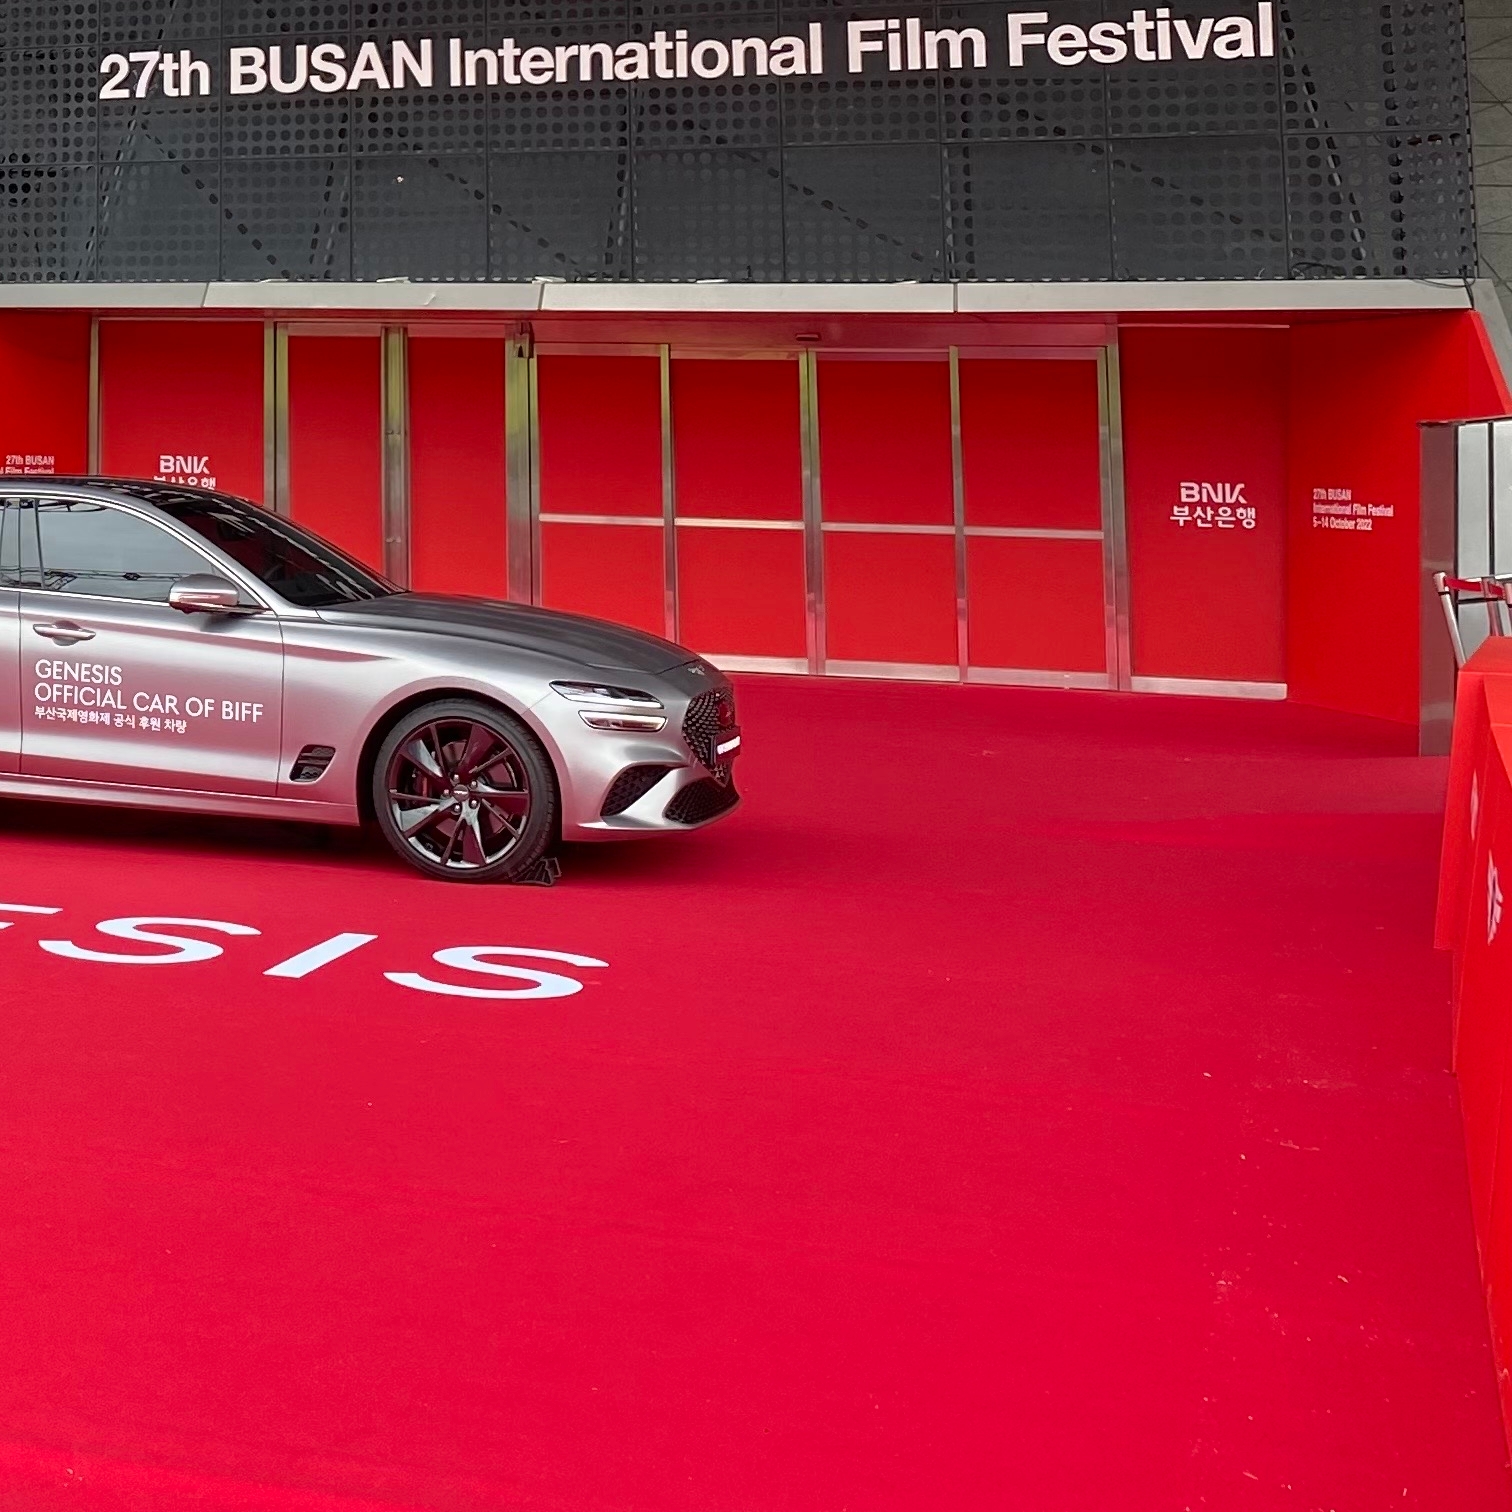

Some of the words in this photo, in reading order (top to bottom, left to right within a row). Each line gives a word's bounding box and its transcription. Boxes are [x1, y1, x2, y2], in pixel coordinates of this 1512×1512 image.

[99, 49, 210, 100] 27th
[230, 39, 432, 94] BUSAN
[450, 23, 821, 87] International
[848, 17, 986, 72] Film
[1009, 1, 1273, 67] Festival
[5, 454, 24, 465] 27th
[25, 455, 55, 465] BUSAN
[159, 455, 210, 474] BNK
[1180, 482, 1247, 504] BNK
[1170, 505, 1256, 529] 부산은행
[1352, 503, 1367, 515] Film
[1367, 503, 1394, 517] Festival
[35, 659, 123, 686] GENESIS
[34, 682, 127, 710] OFFICIAL
[133, 692, 180, 715] CAR
[185, 697, 215, 717] OF
[221, 700, 264, 723] BIFF
[34, 705, 110, 726] 부산국제영화제
[114, 713, 136, 729] 공식
[139, 716, 161, 732] 후원
[164, 719, 187, 734] 차량
